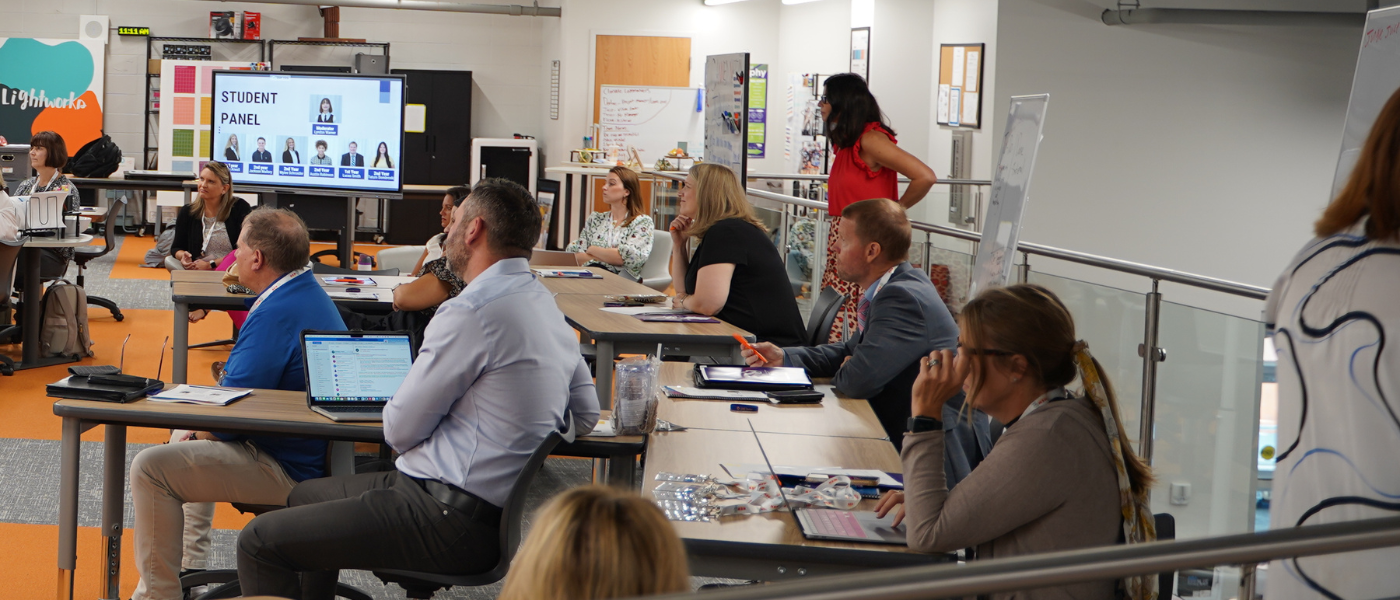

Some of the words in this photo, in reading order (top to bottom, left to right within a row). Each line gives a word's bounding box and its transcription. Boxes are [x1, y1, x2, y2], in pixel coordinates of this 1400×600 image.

[2, 88, 87, 110] Lightworks
[221, 91, 278, 104] STUDENT
[221, 113, 260, 125] PANEL
